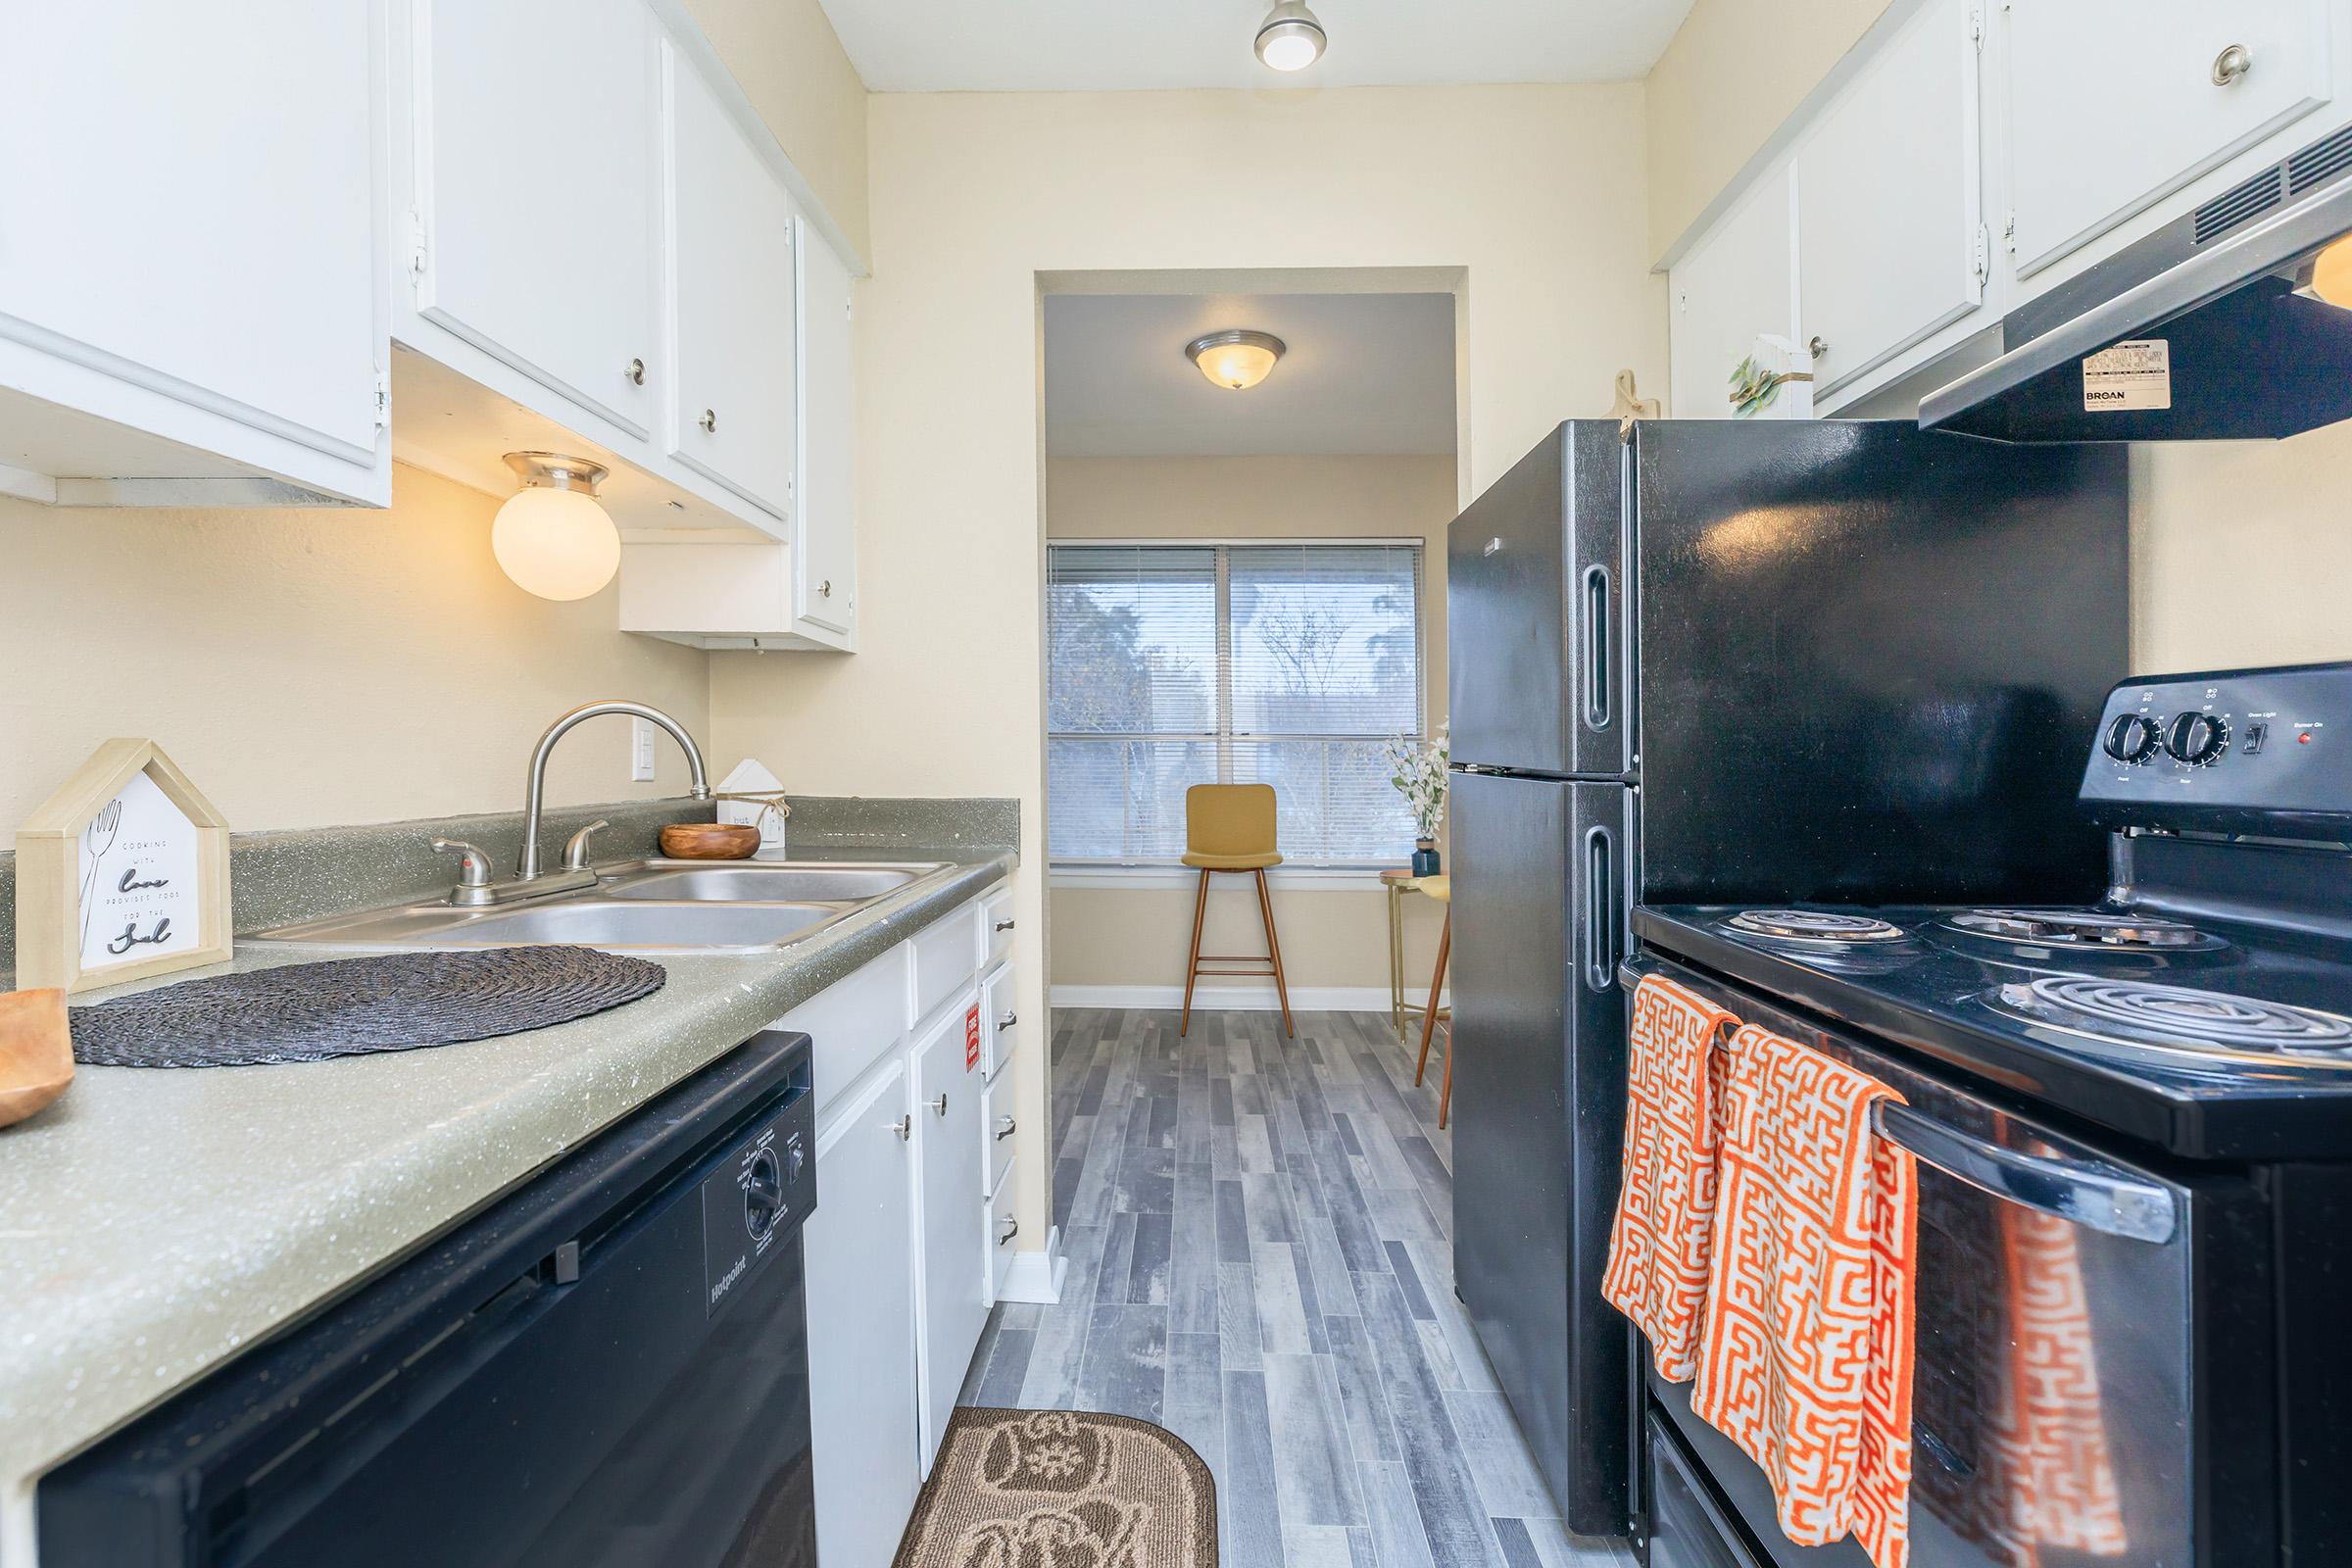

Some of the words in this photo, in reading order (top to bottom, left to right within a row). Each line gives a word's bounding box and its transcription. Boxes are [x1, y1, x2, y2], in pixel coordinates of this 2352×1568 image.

[2086, 391, 2125, 400] BROAN
[122, 840, 167, 850] COOKING
[106, 894, 150, 905] PROVIDES
[711, 1254, 747, 1303] Hotpoint
